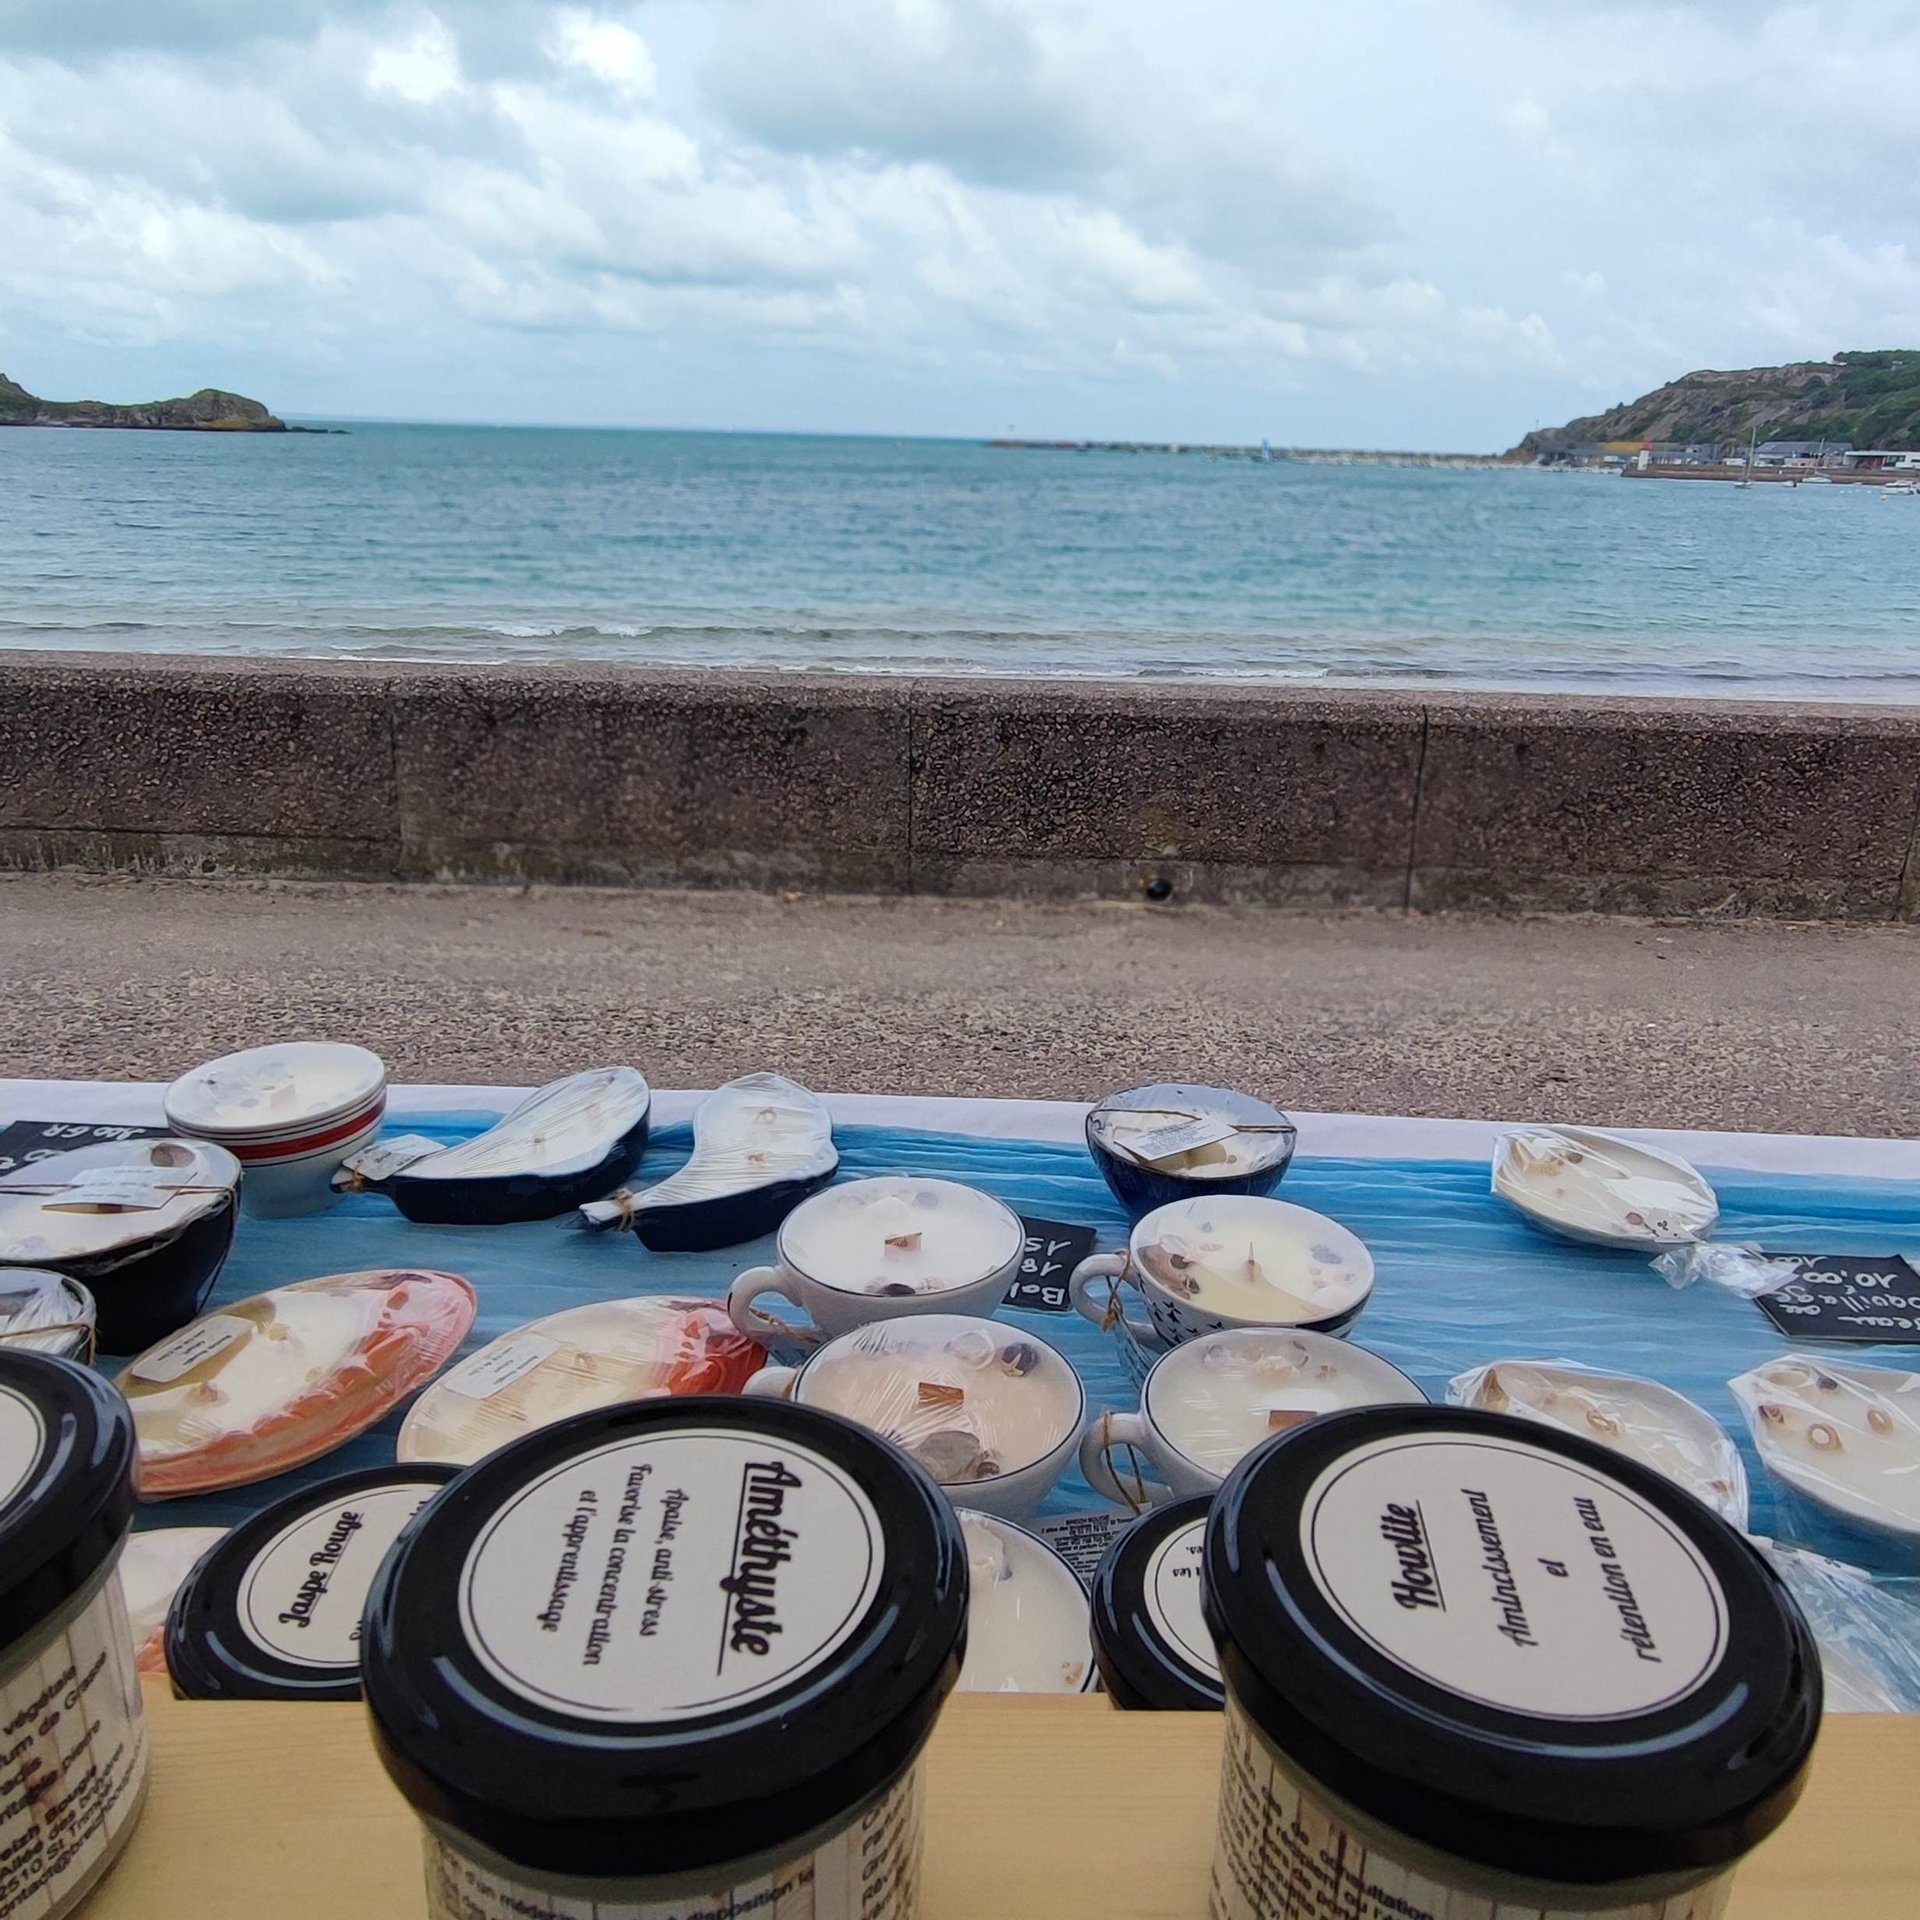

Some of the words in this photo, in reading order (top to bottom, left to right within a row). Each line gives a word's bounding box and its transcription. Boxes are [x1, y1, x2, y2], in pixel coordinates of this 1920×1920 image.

[1010, 1282, 1066, 1305] Bol
[1021, 1257, 1063, 1276] 18
[578, 1489, 600, 1504] et
[616, 1462, 653, 1526] Favorise
[654, 1487, 690, 1545] Apaise,
[1572, 1496, 1606, 1533] eau
[612, 1527, 637, 1545] la
[718, 1460, 803, 1657] Améthyste
[1380, 1502, 1441, 1611] Howlite
[1459, 1487, 1540, 1649] Amincissement
[1536, 1556, 1570, 1578] et
[1588, 1534, 1617, 1560] en
[278, 1570, 329, 1631] Jaspe
[312, 1510, 363, 1574] Rouge
[536, 1506, 599, 1633] l'apprentissage
[639, 1547, 674, 1637] anti-stress
[581, 1545, 627, 1667] concentration
[1599, 1562, 1663, 1664] rétention
